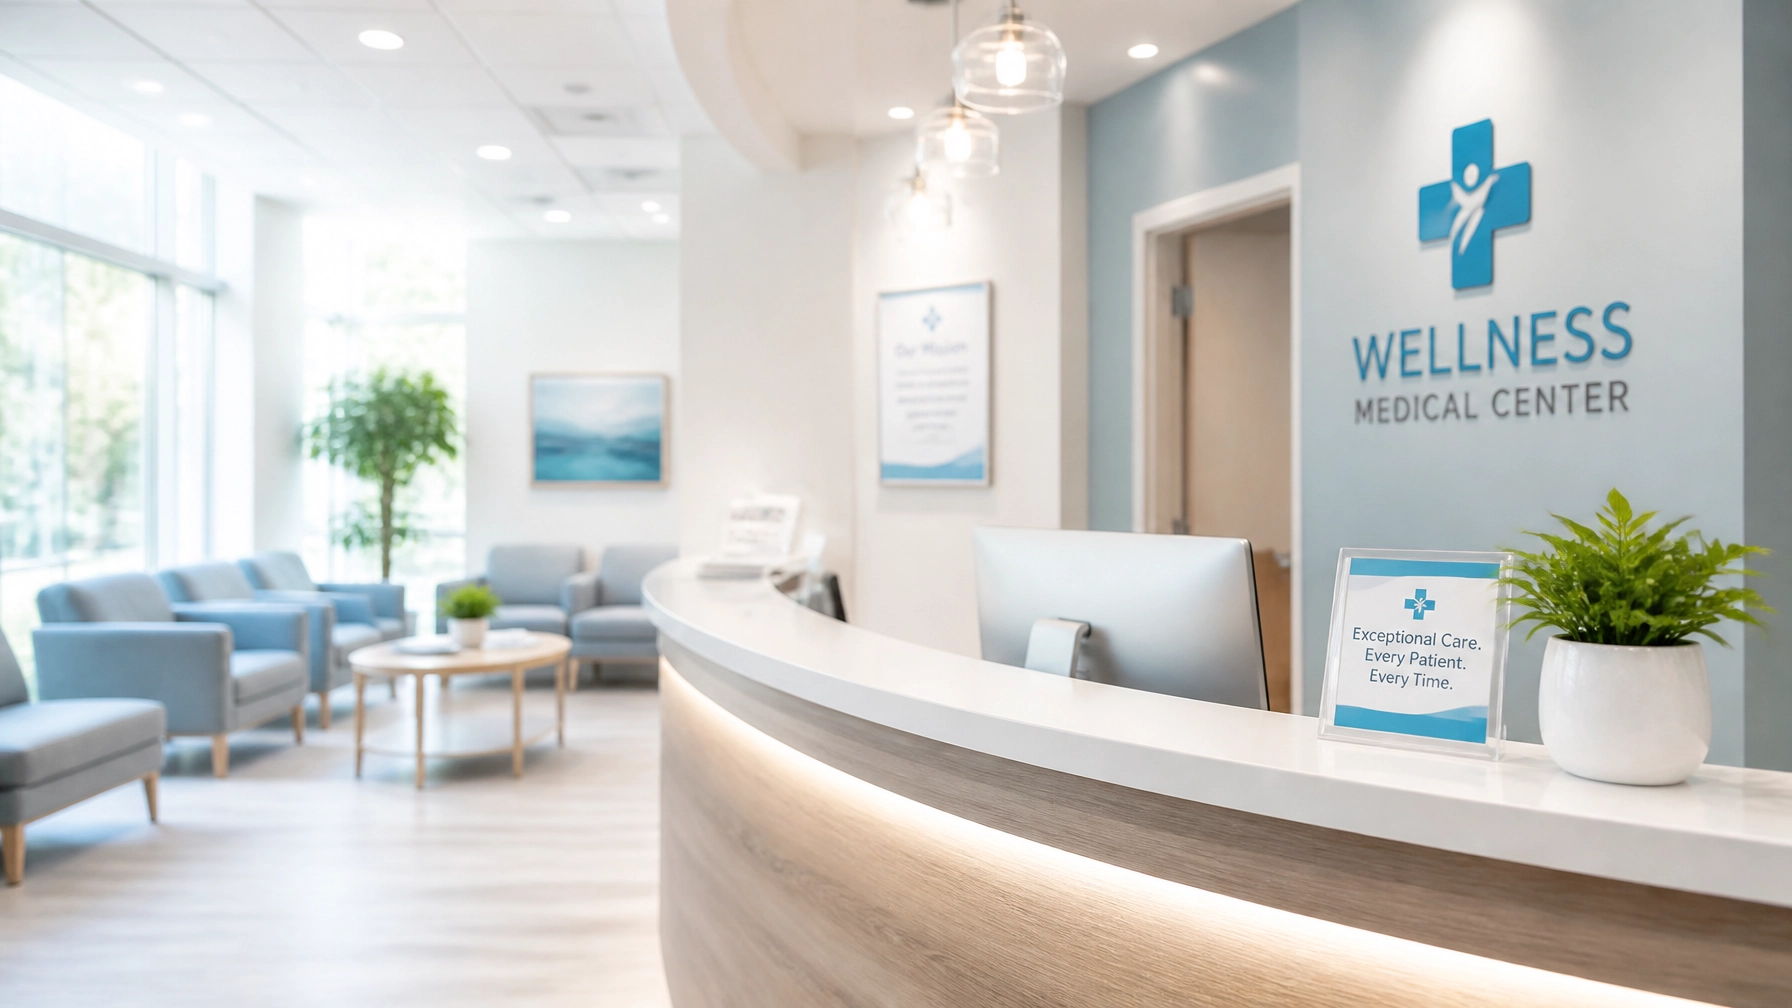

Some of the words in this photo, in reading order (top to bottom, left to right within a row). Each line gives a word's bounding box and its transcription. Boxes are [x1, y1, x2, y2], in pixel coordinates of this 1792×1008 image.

[1353, 301, 1633, 382] WELLNESS
[1354, 392, 1478, 424] MEDICAL
[1491, 380, 1629, 418] CENTER
[1352, 626, 1437, 647] Exceptional
[1441, 633, 1482, 651] Care.
[1364, 648, 1406, 668] Every
[1409, 651, 1467, 670] Patient.
[1369, 668, 1410, 689] Every
[1413, 672, 1453, 690] Time.
